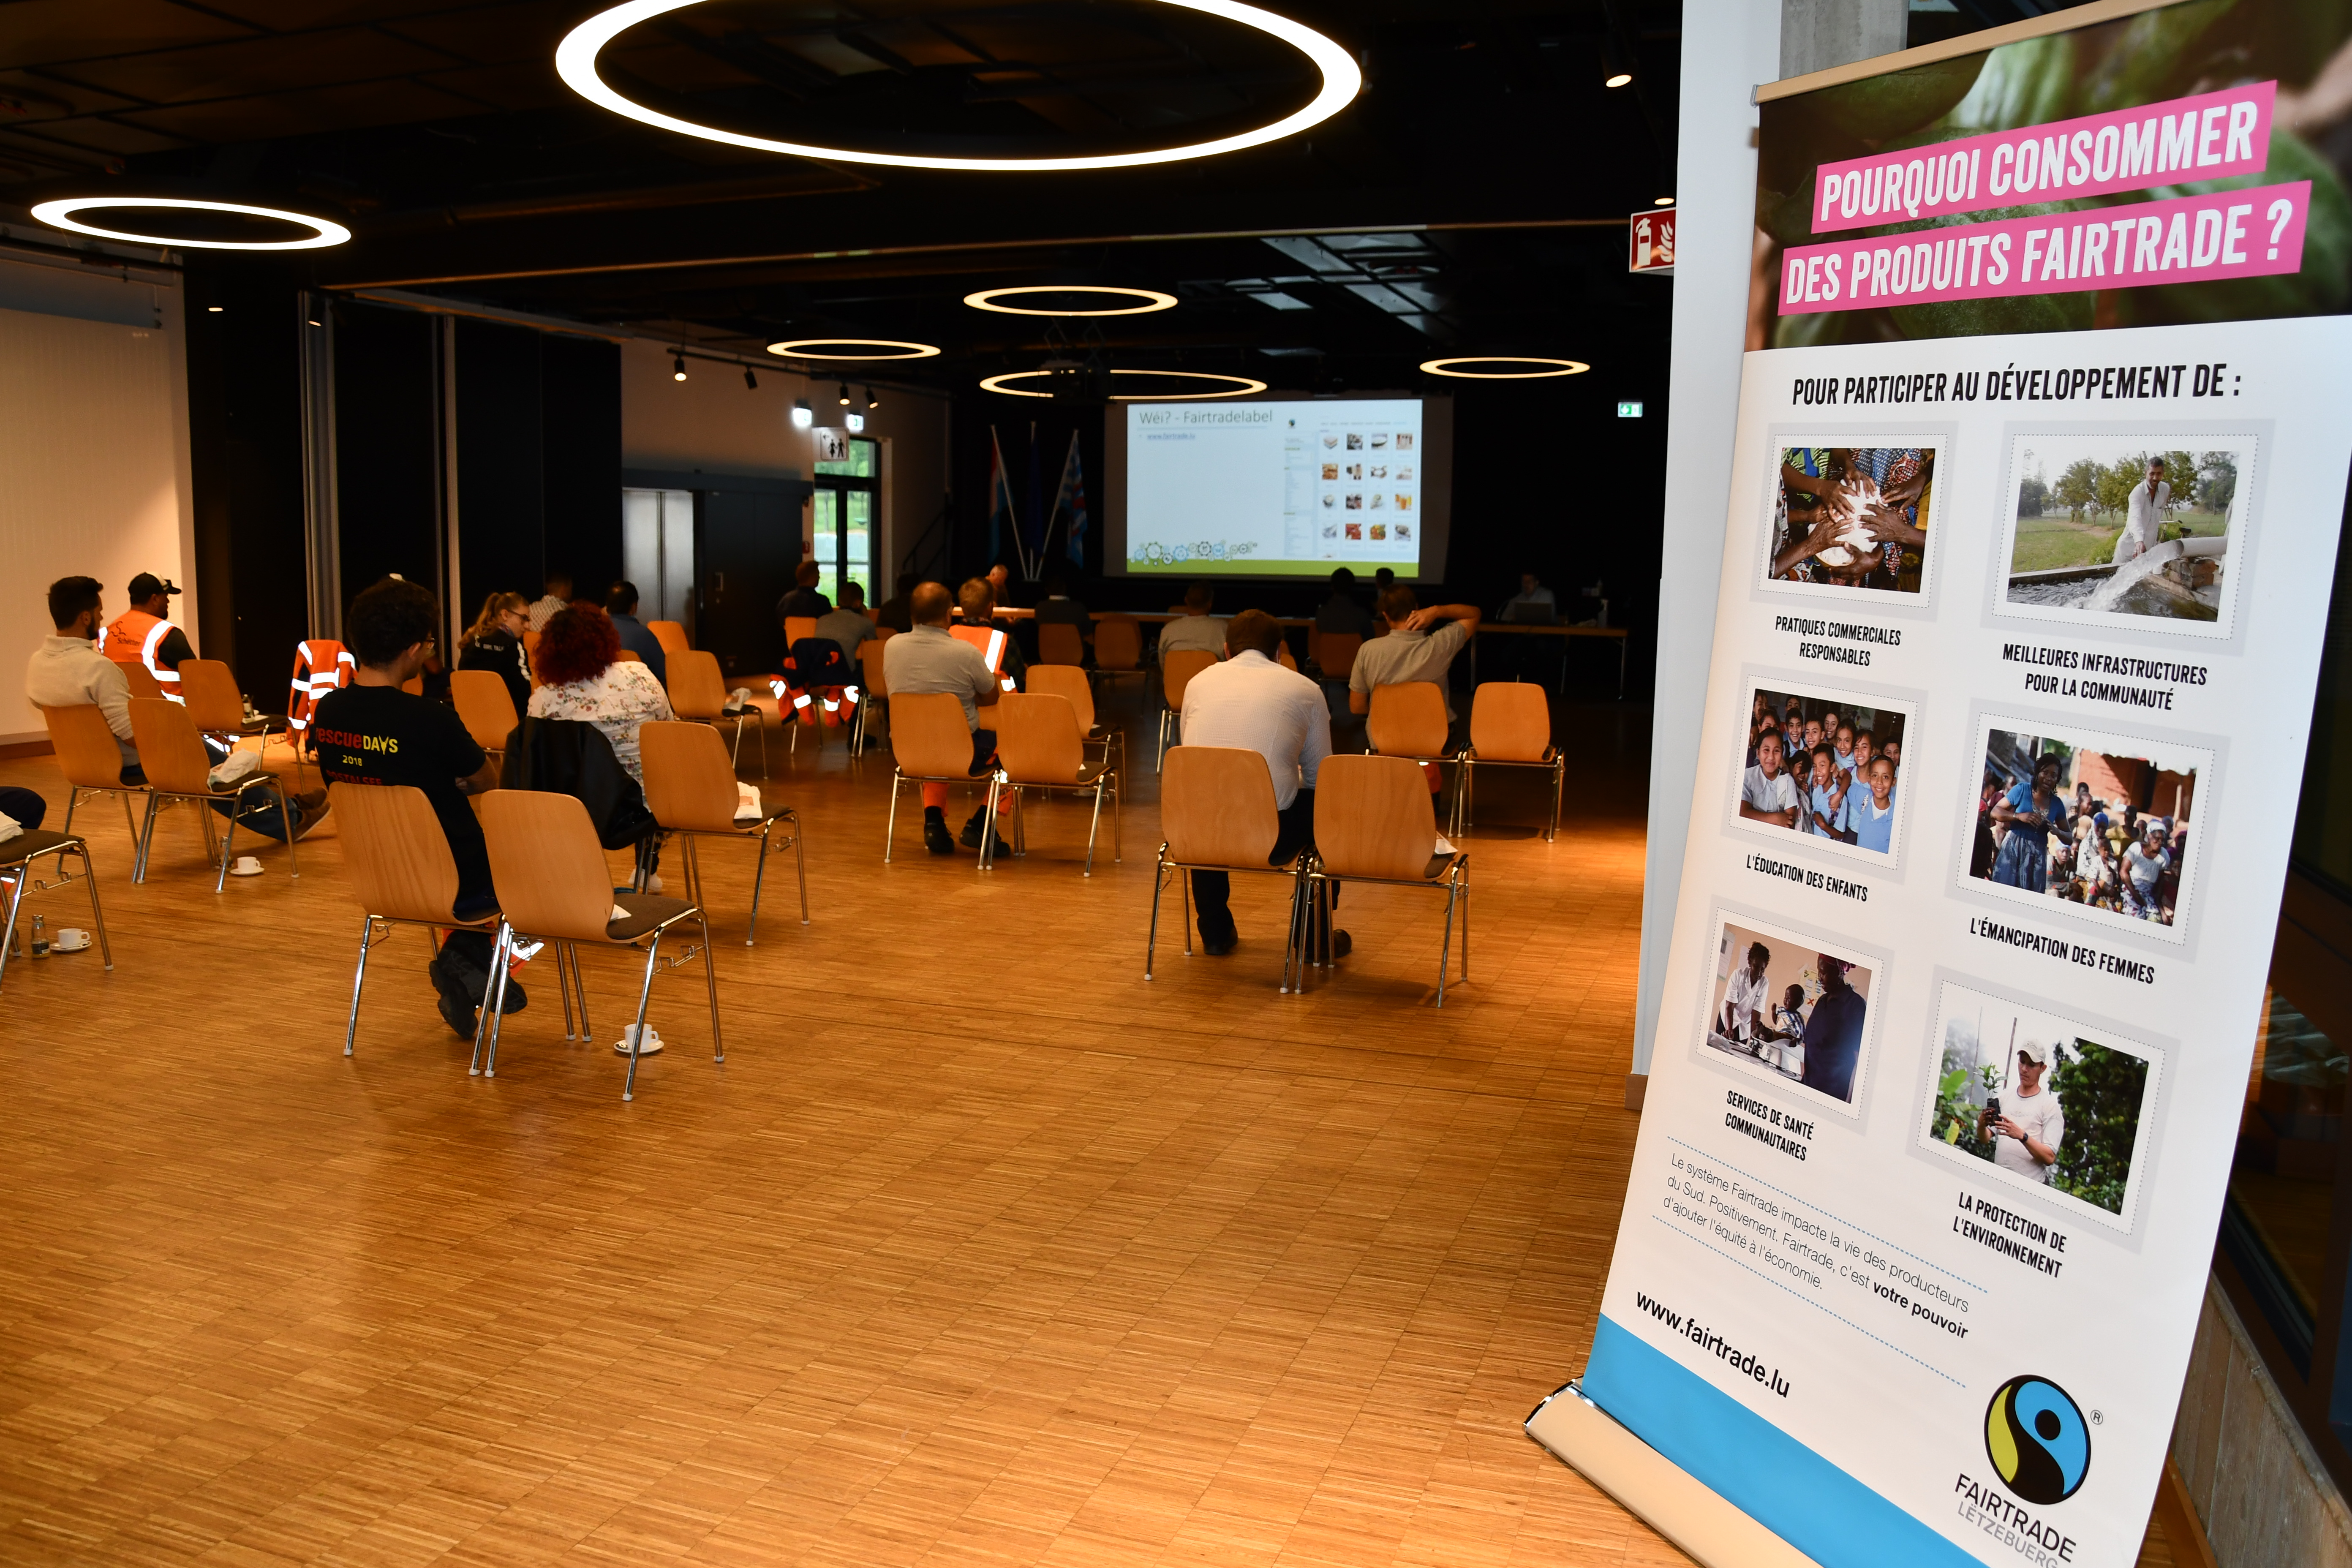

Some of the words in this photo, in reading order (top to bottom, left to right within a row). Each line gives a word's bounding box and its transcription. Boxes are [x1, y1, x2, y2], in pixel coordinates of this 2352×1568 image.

[1821, 149, 1980, 221] POURQUOI
[1990, 101, 2257, 196] CONSOMMER
[1787, 254, 1841, 303] DES
[1850, 233, 2011, 298] PRODUITS
[2022, 204, 2252, 282] FAIRTRADE
[1793, 378, 1838, 405] POUR
[1844, 373, 1946, 404] PARTICIPER
[1952, 372, 1979, 401] AU
[1986, 363, 2186, 400] DÉVELOPPEMENT
[2193, 364, 2227, 397] DE
[1140, 411, 1171, 424] Wéi?
[1184, 409, 1273, 423] Fairtradelabel
[1775, 616, 1825, 636] PRATIQUES
[1828, 622, 1900, 645] COMMERCIALES
[1799, 642, 1870, 666] RESPONSABLES
[2003, 644, 2078, 669] MEILLEURES
[2082, 653, 2207, 685] INFRASTRUCTURES
[2025, 673, 2058, 694] POUR
[2062, 678, 2076, 696] LA
[2081, 681, 2173, 710] COMMUNAUTÉ
[343, 755, 362, 766] 2018
[1747, 853, 1804, 883] L'ÉDUCATION
[1806, 871, 1824, 888] DES
[1826, 877, 1867, 901] ENFANTS
[1970, 917, 2068, 959] L'ÉMANCIPATION
[2072, 945, 2096, 967] DES
[2099, 953, 2154, 984] FEMMES
[1726, 1113, 1806, 1161] COMMUNAUTAIRES
[1727, 1090, 1768, 1119] SERVICES
[1770, 1109, 1782, 1126] DE
[1784, 1115, 1814, 1140] SANTÉ
[1664, 1196, 1707, 1227] d'ajouter
[1710, 1218, 1746, 1248] l'équité
[1749, 1239, 1756, 1254] à
[1759, 1244, 1822, 1289] l'économie.
[1672, 1153, 1684, 1169] Le
[1687, 1164, 1729, 1191] système
[1731, 1182, 1778, 1216] Fairtrade
[1781, 1207, 1827, 1240] impacte
[1830, 1231, 1840, 1248] la
[1844, 1241, 1859, 1257] vie
[1864, 1250, 1886, 1270] des
[1889, 1264, 1968, 1312] producteurs
[1953, 1216, 2062, 1278] L'ENVIRONNEMENT
[1959, 1192, 1971, 1211] LA
[1976, 1199, 2047, 1244] PROTECTION
[2050, 1232, 2066, 1253] DE
[1668, 1176, 1680, 1190] du
[1683, 1182, 1705, 1204] Sud.
[1710, 1195, 1778, 1242] Positivement.
[1783, 1233, 1835, 1273] Fairtrade,
[1840, 1266, 1870, 1288] c'est
[1874, 1282, 1908, 1308] votre
[1911, 1302, 1968, 1338] pouvoir
[1637, 1292, 1789, 1398] www.fairtrade.lu
[1955, 1473, 2076, 1563] FAIRTRADE
[1957, 1501, 2058, 1568] LËTZEBUERG
